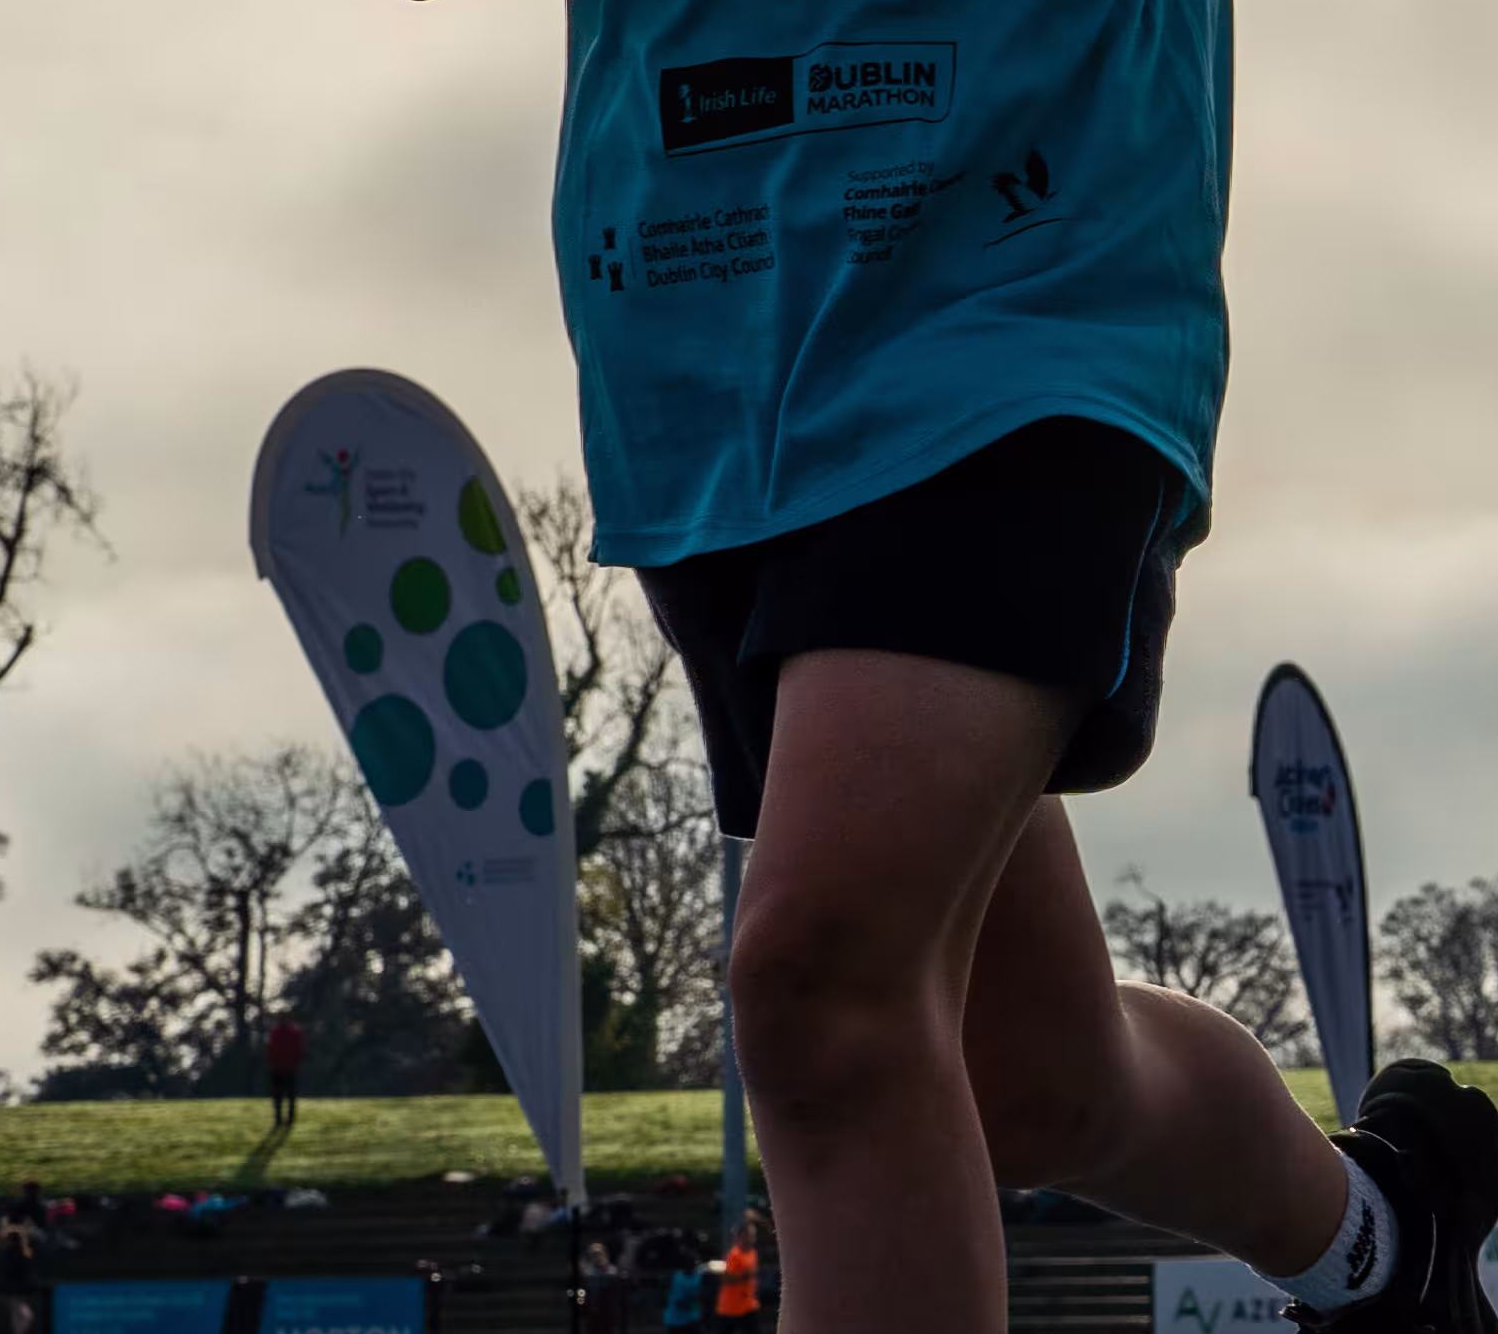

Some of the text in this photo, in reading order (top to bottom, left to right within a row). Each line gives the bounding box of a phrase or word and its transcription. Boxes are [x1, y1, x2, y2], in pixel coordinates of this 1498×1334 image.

[808, 61, 936, 93] DUBLIN
[698, 83, 777, 113] Irish Life
[807, 88, 935, 115] MARATHON
[647, 265, 697, 288] Dublin
